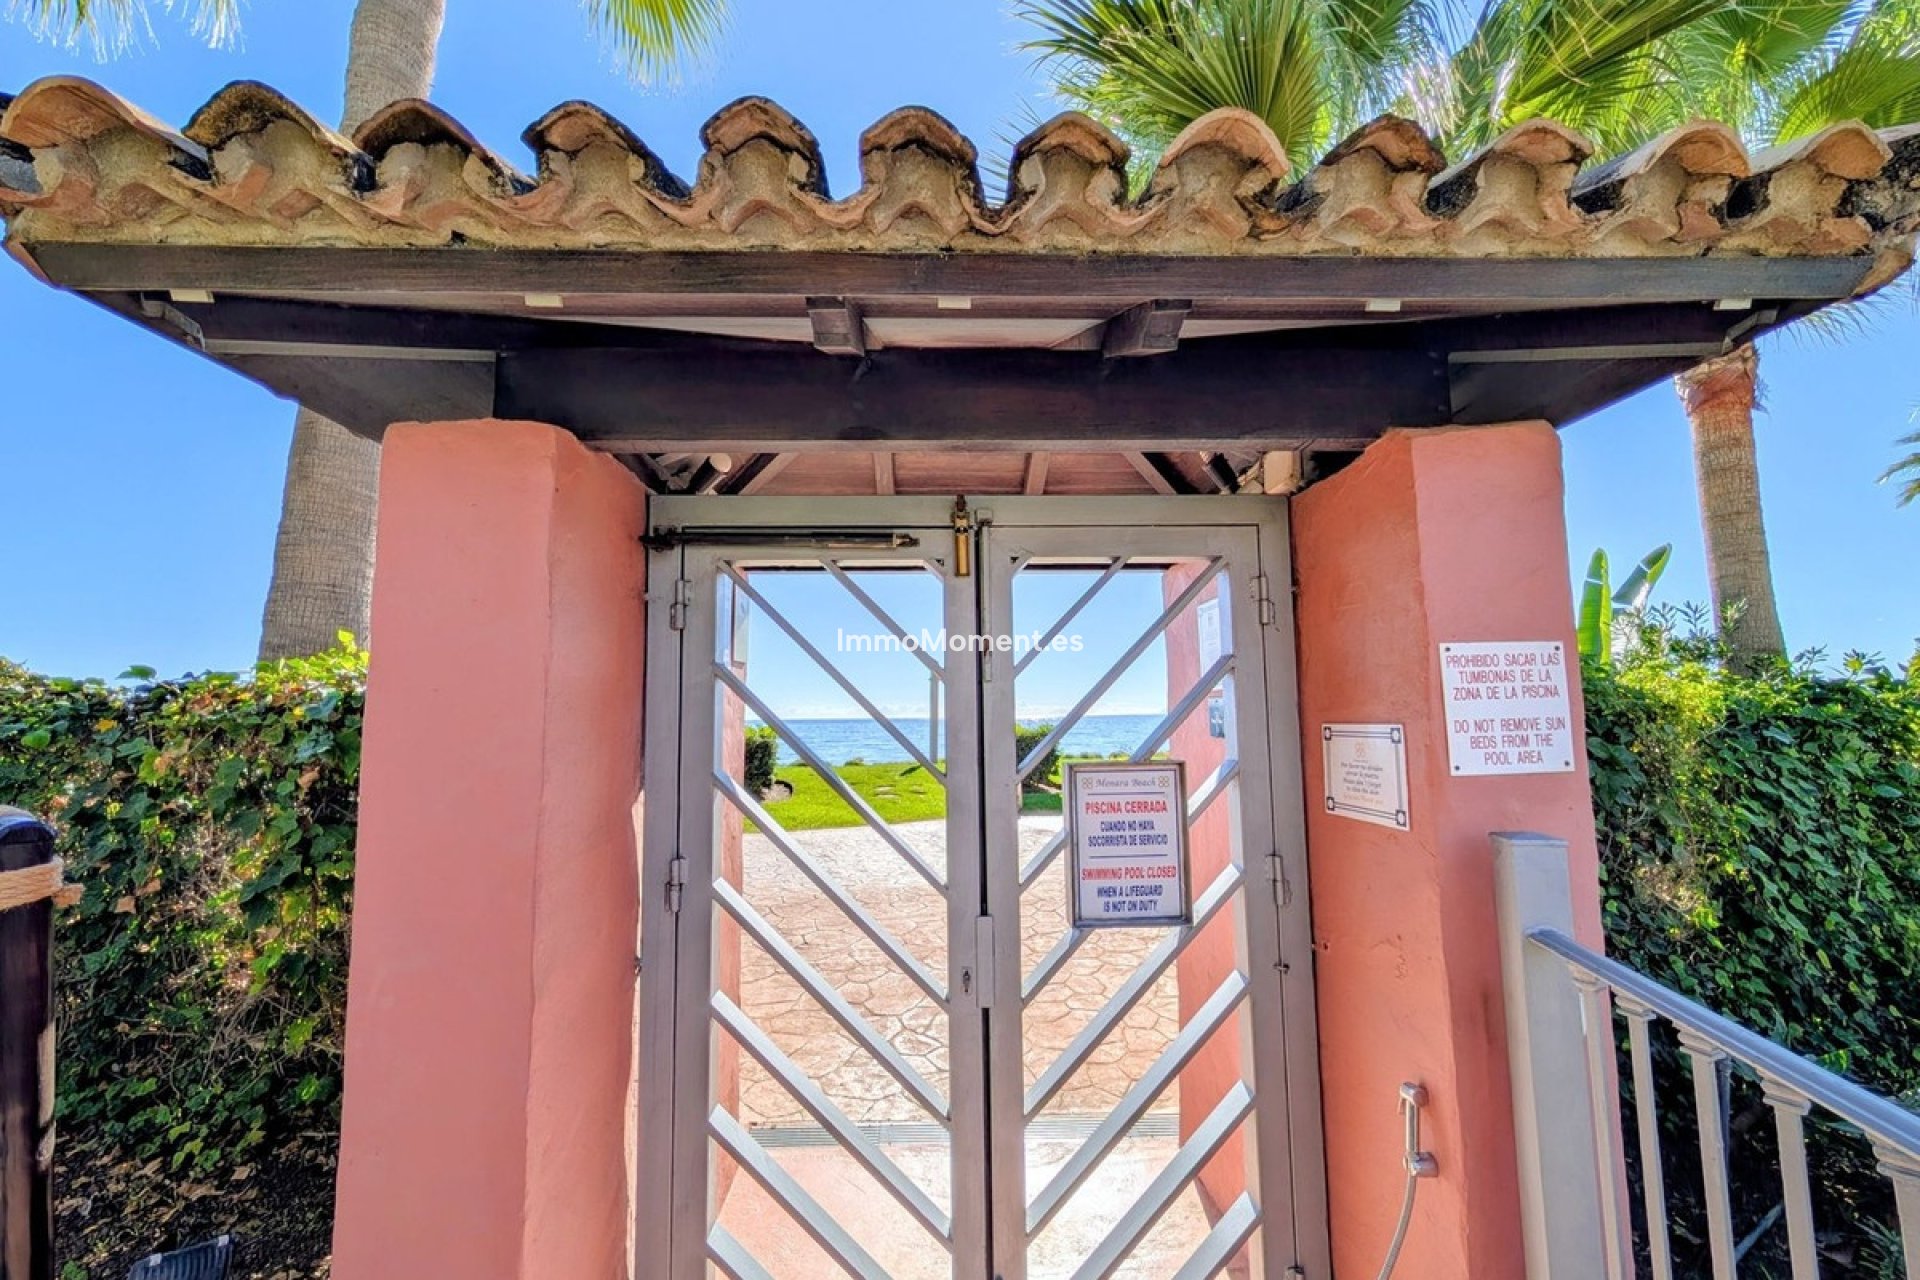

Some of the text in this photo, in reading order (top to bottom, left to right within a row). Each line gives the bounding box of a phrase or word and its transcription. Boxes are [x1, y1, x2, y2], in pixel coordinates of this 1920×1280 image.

[1446, 653, 1560, 668] PROHIBIDO SACAR LAS
[1459, 669, 1552, 683] TUMBONAS DE LA
[1454, 685, 1560, 701] ZONA DE LA PISCINA
[1454, 717, 1566, 733] DO NOT REMOVE SUN
[1470, 734, 1553, 749] BEDS FROM THE
[1485, 750, 1543, 765] POOL AREA
[1133, 777, 1156, 787] Beach
[1085, 801, 1168, 814] PISCINA CERRADA
[1101, 820, 1155, 832] CUANDO NO HAYA
[1088, 834, 1168, 847] SOCORRISTA DE SERVICIO
[1082, 866, 1176, 880] SWIMMING POOL CLOSED
[1097, 885, 1163, 897] WHEN A LIFEGUARD
[1104, 901, 1158, 912] IS NOT ON DUTY
